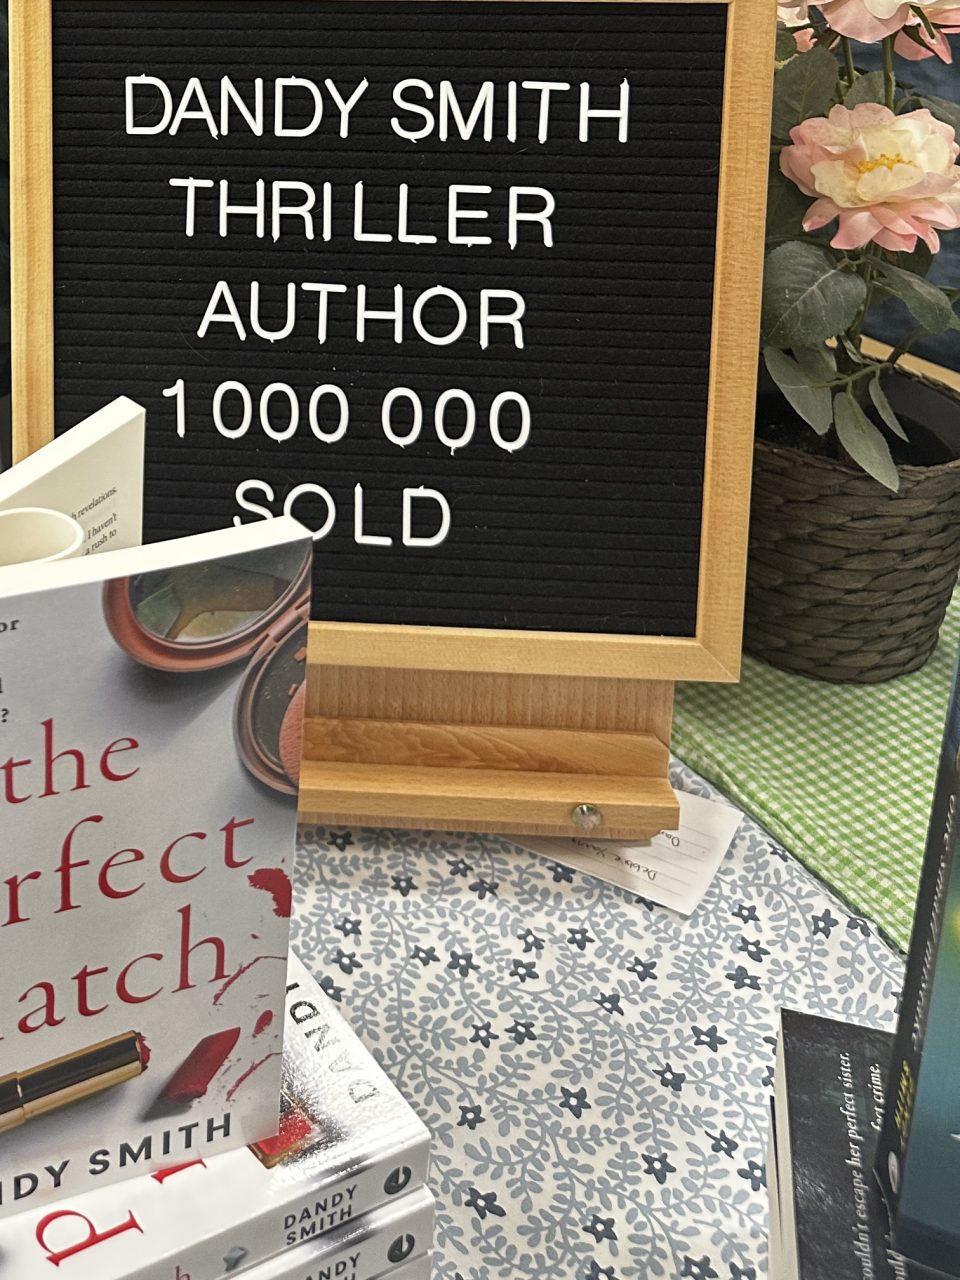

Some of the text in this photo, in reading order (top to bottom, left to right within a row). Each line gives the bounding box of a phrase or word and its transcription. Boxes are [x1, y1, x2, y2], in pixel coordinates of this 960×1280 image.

[125, 74, 630, 143] DANDY SMITH
[169, 177, 556, 250] THRILLER
[196, 280, 526, 350] AUTHOR
[381, 387, 531, 455] 000
[109, 528, 118, 539] to
[232, 478, 452, 548] SOLD
[0, 717, 140, 805] the
[836, 1051, 855, 1088] sister.
[867, 1063, 887, 1106] crime.
[840, 1090, 865, 1143] perfect
[88, 1112, 232, 1176] SMITH
[845, 1141, 863, 1169] her
[283, 1183, 358, 1231] DANDY
[851, 1169, 869, 1218] escape
[286, 1204, 353, 1247] SMITH
[304, 1252, 361, 1280] ANDY
